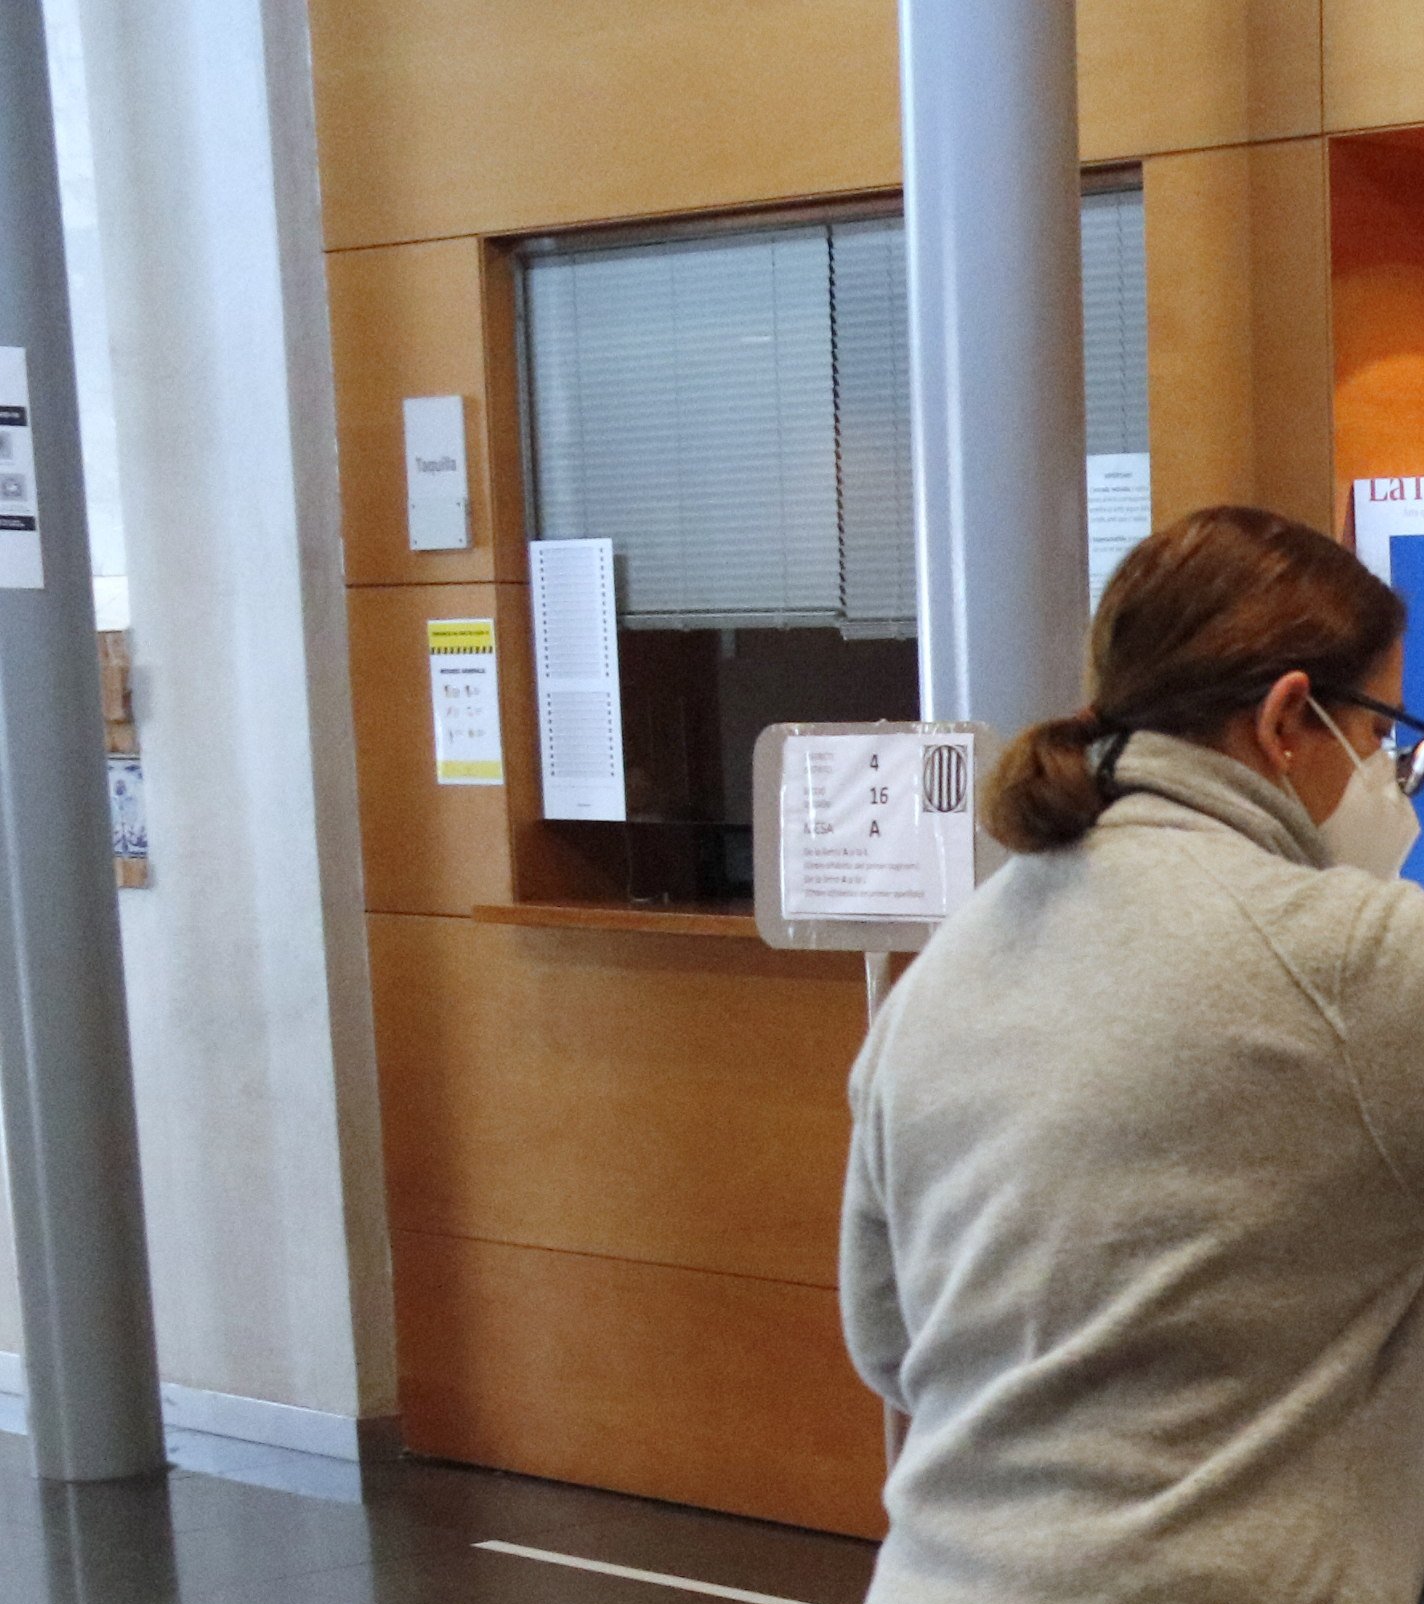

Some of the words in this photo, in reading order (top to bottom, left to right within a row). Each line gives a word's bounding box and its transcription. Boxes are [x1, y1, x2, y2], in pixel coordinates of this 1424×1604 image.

[869, 753, 879, 772] 4
[869, 786, 889, 805] 16
[869, 819, 880, 838] A
